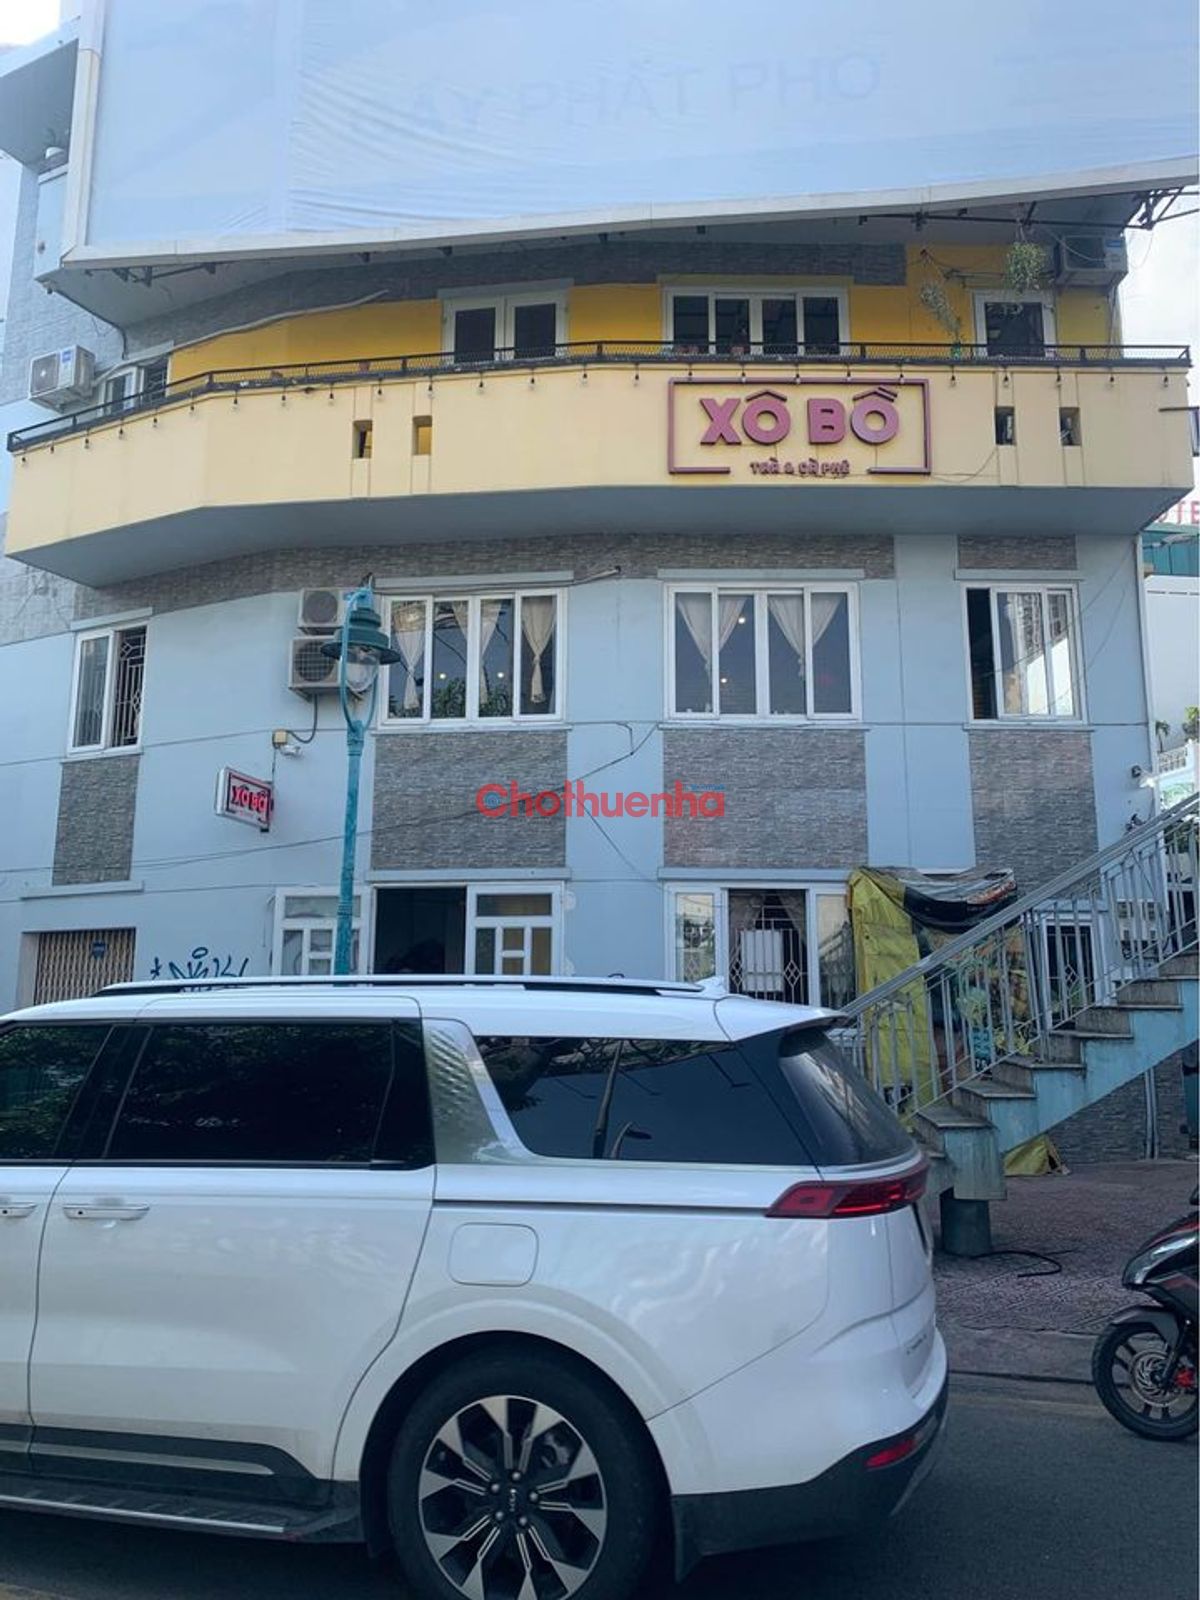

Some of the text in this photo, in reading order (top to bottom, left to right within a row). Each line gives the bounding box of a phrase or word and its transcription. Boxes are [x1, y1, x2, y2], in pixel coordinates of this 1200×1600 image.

[700, 385, 900, 445] XÔ BỒ
[784, 461, 795, 475] &
